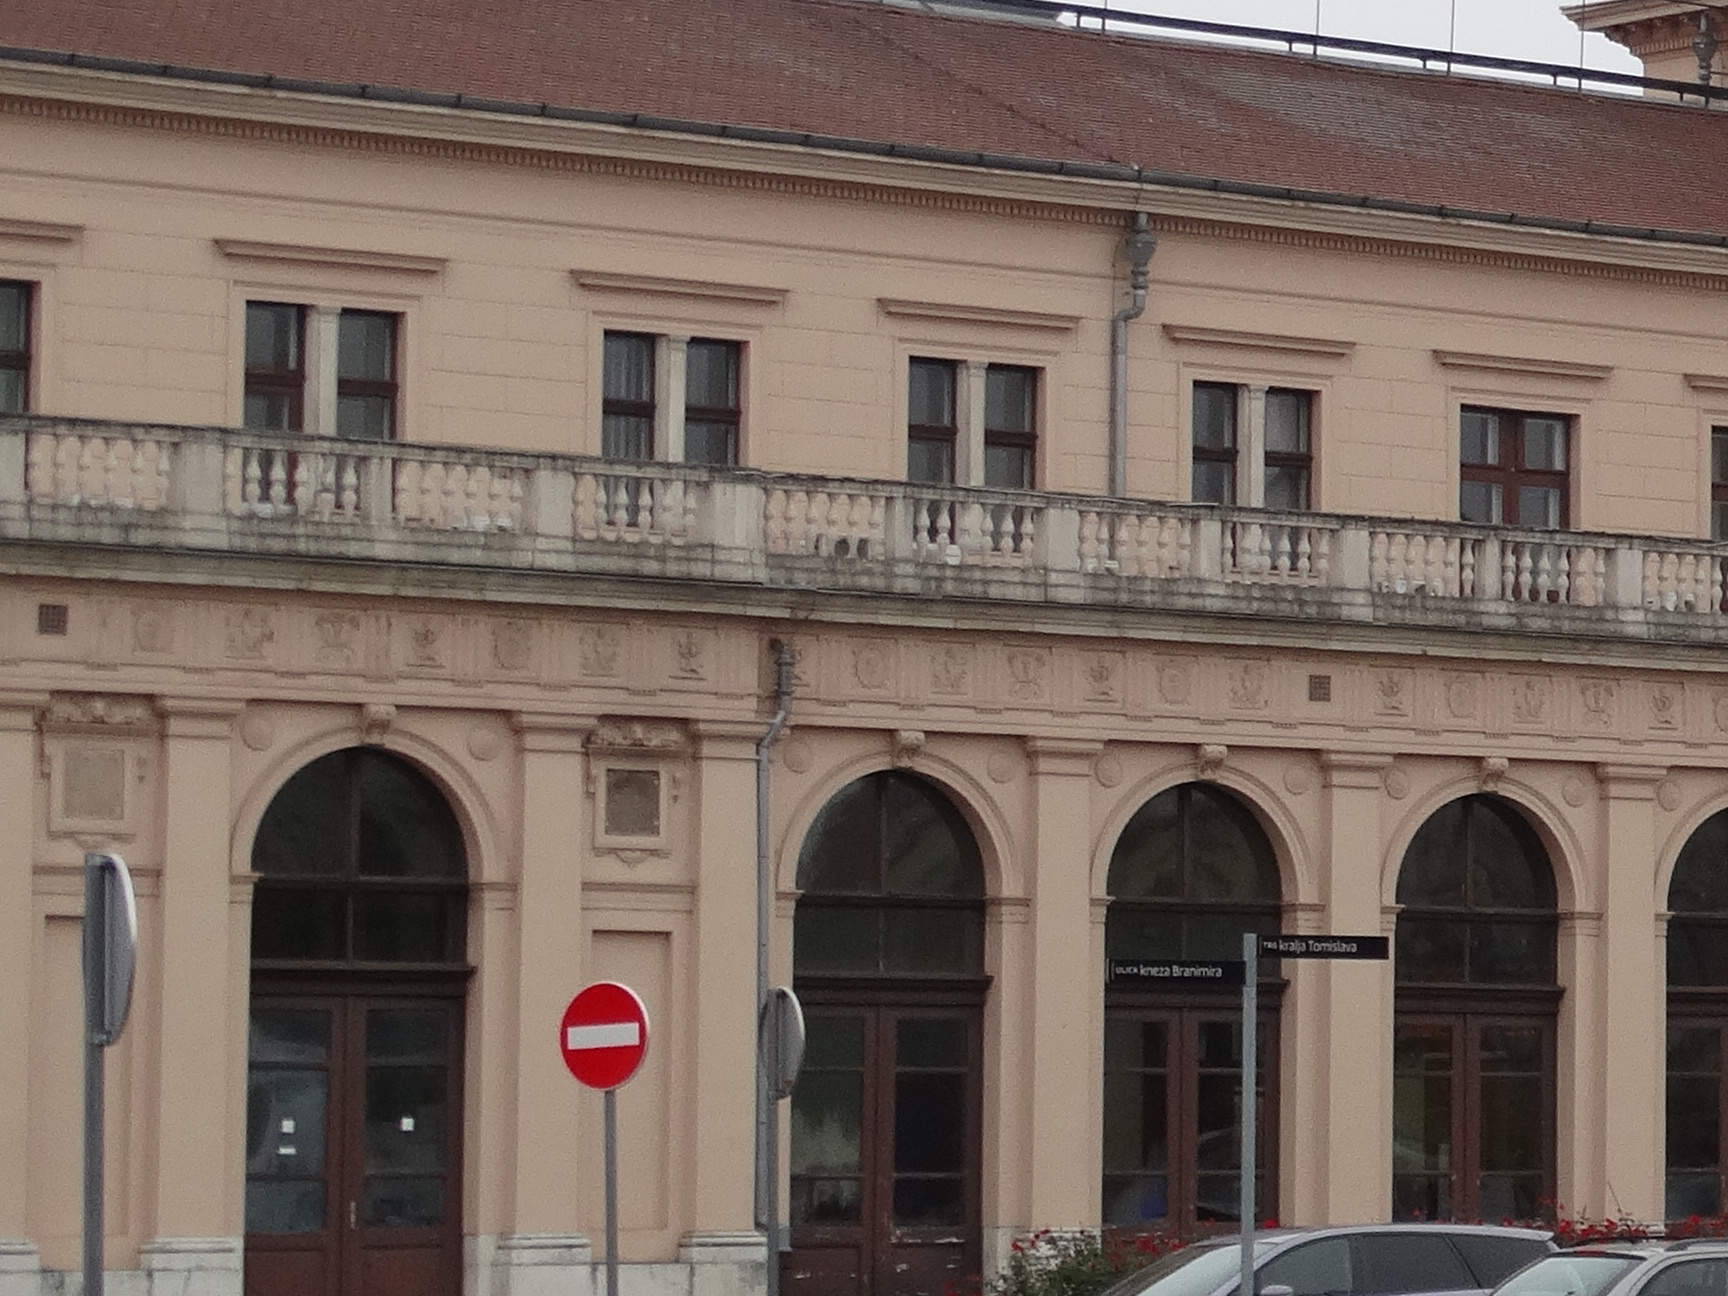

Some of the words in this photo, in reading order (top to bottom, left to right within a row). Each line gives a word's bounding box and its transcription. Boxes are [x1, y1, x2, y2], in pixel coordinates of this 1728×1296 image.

[1279, 939, 1306, 954] kralja
[1308, 940, 1358, 952] Tomislava
[1139, 964, 1170, 977] kneza
[1172, 964, 1223, 977] Branimira
